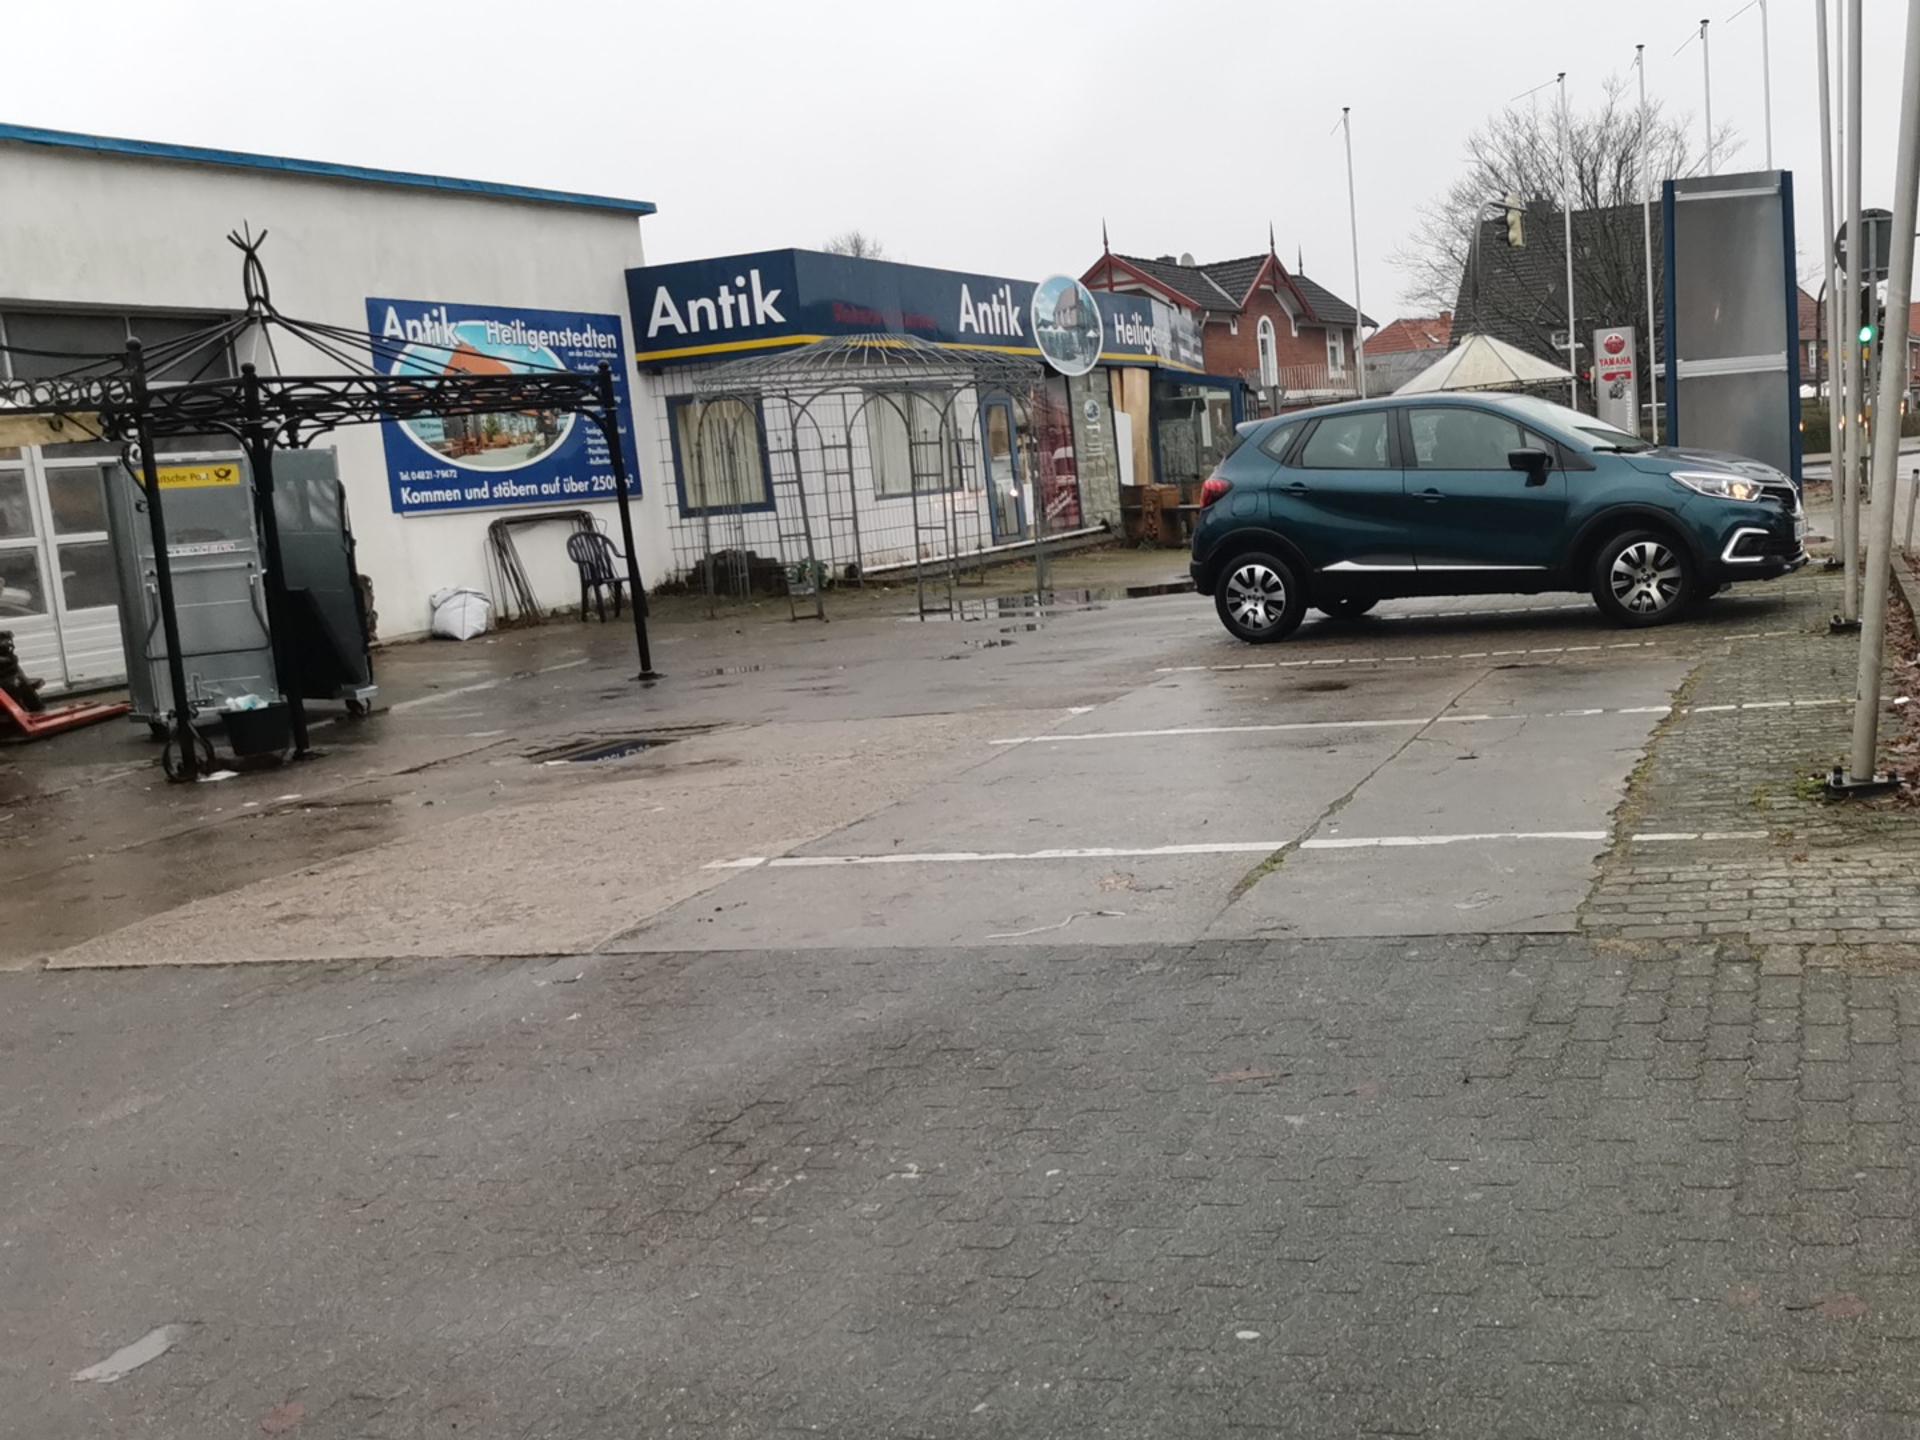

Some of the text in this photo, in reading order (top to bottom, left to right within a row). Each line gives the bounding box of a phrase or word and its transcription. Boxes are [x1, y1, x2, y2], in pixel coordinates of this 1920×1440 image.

[647, 268, 787, 338] Antik
[958, 282, 1024, 337] Antik
[383, 306, 616, 352] Antik Heiligenstedten
[1599, 356, 1632, 367] YAMAHA
[401, 487, 461, 504] Kommen
[464, 481, 489, 500] und
[493, 479, 538, 497] stöbern
[541, 476, 560, 494] auf
[563, 476, 589, 493] über
